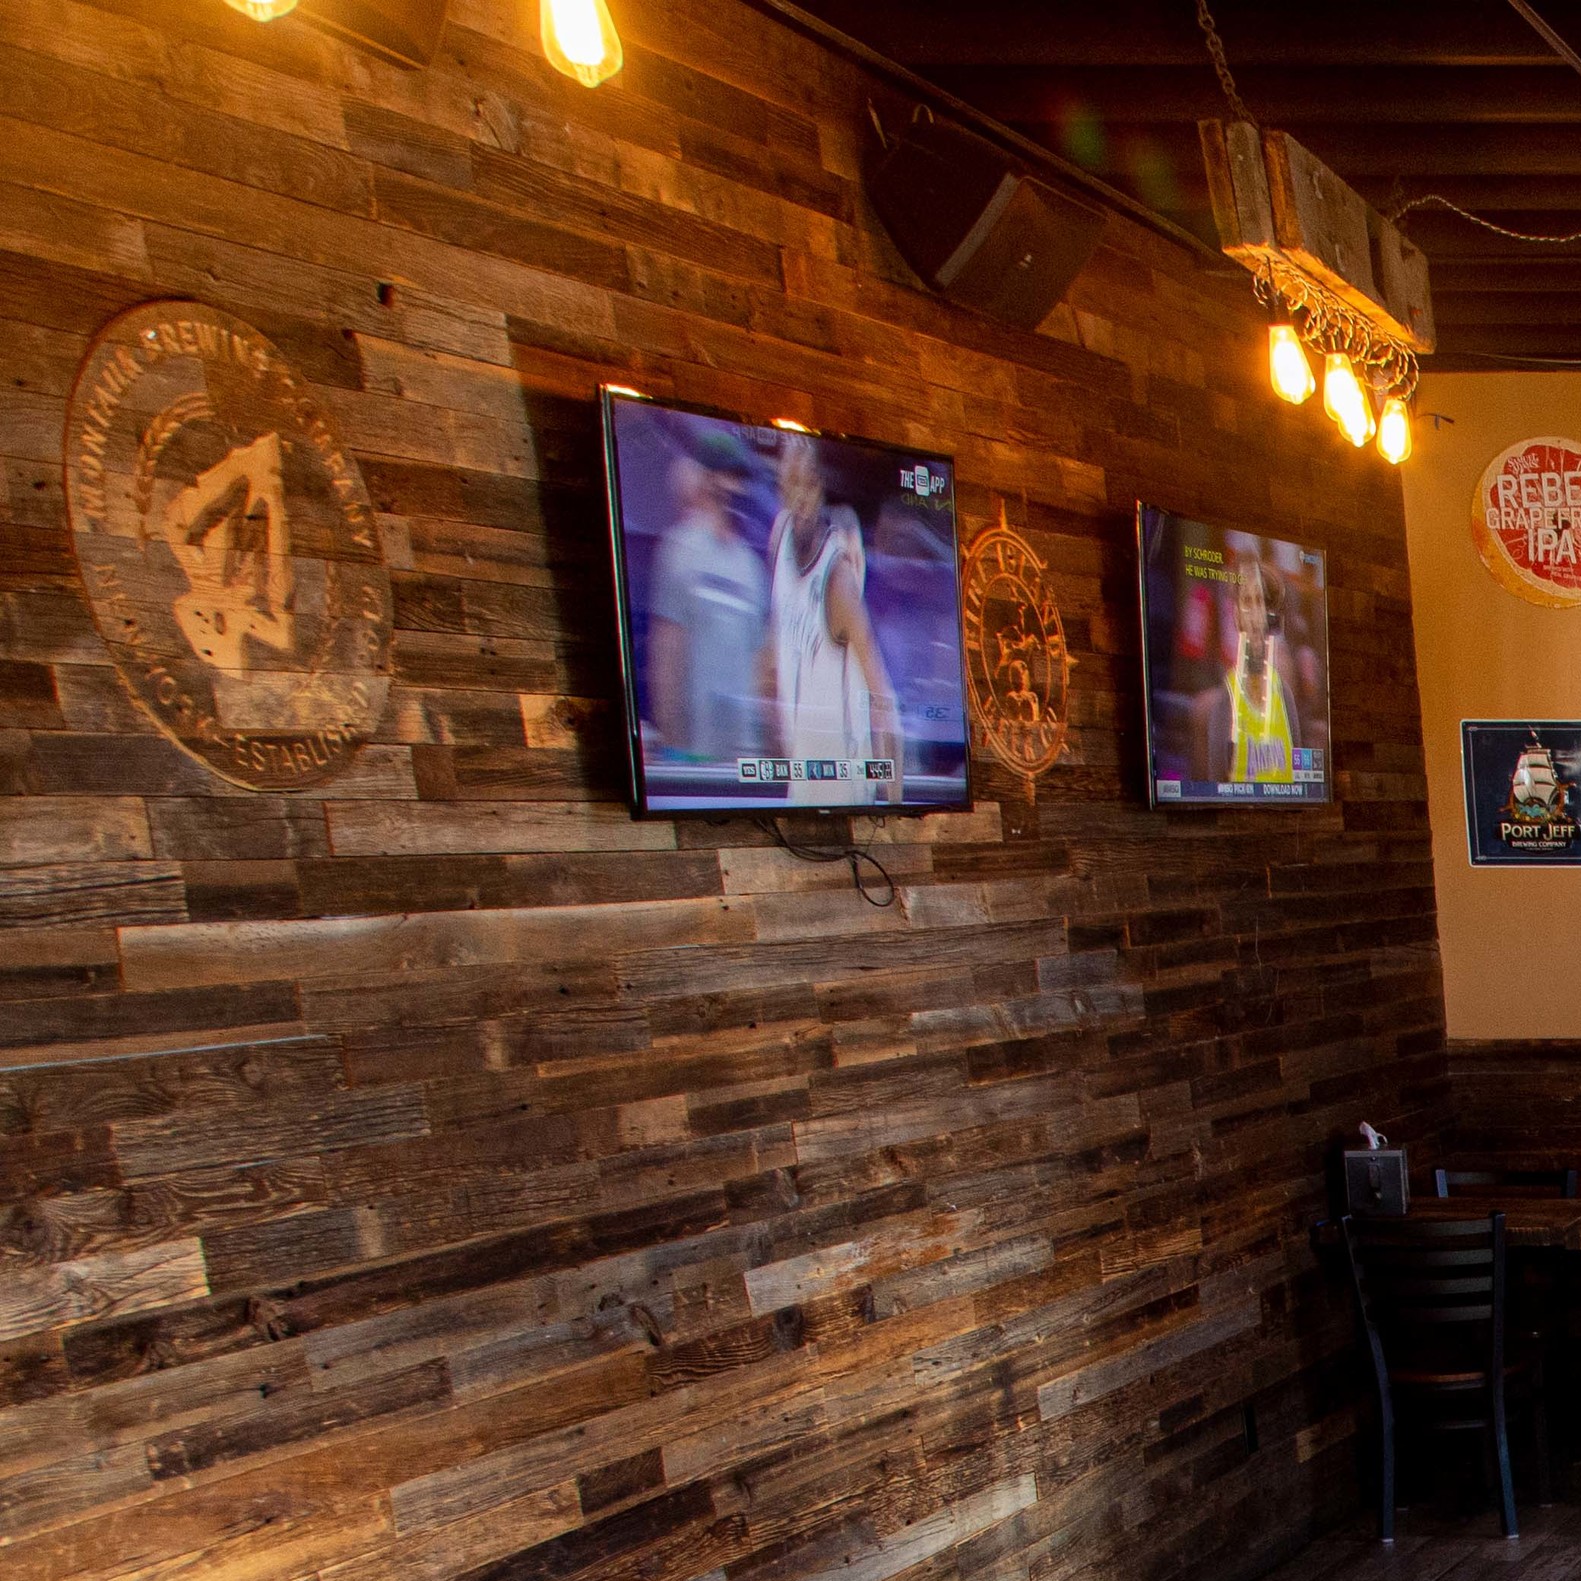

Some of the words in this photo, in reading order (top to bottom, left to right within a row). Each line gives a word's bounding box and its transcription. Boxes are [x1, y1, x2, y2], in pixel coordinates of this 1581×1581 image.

[900, 469, 914, 489] THE
[929, 476, 945, 494] APP
[1184, 546, 1193, 558] BY
[1527, 528, 1577, 564] IPA
[1186, 565, 1193, 577] HE
[1195, 567, 1207, 579] WAS
[1208, 569, 1228, 583] TRYING
[1229, 572, 1237, 584] TO
[794, 763, 802, 777] 55
[1263, 784, 1290, 795] DOWNLOAD
[1291, 785, 1303, 795] NOW
[1501, 822, 1540, 840] PORT
[1543, 823, 1575, 840] JEFF
